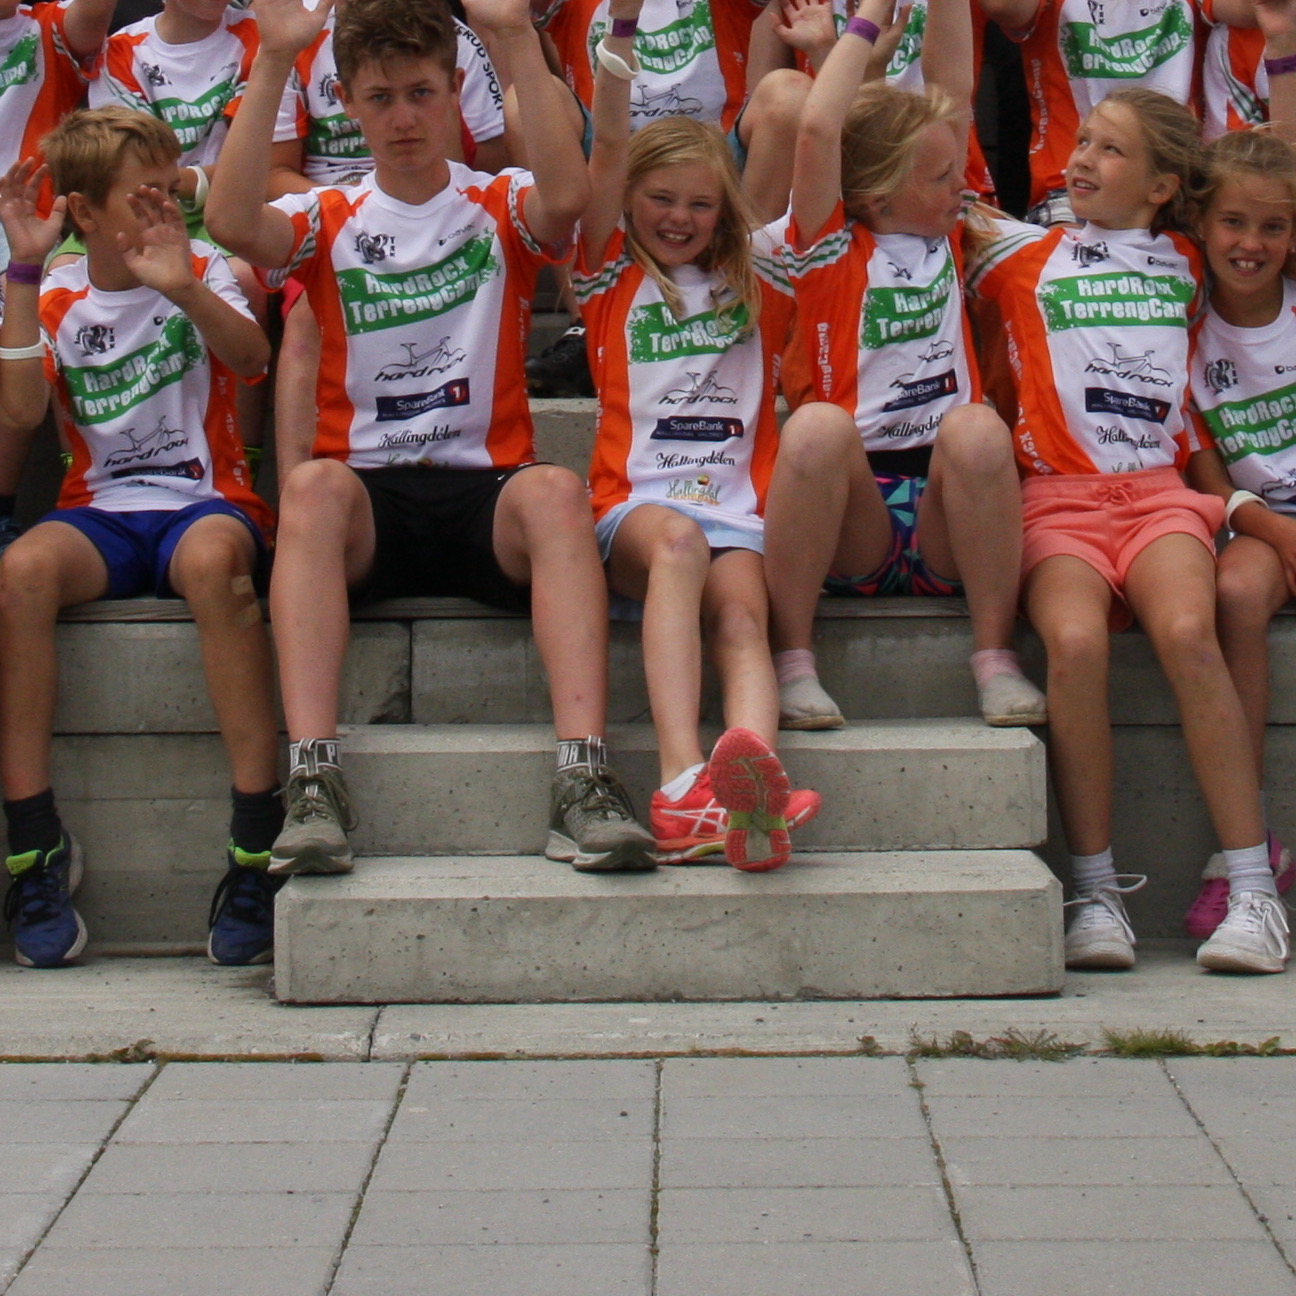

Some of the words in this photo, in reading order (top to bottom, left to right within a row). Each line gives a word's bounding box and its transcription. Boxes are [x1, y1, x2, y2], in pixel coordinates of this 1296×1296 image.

[453, 386, 464, 401] 1
[669, 420, 724, 434] SpareBank
[728, 425, 738, 437] 1
